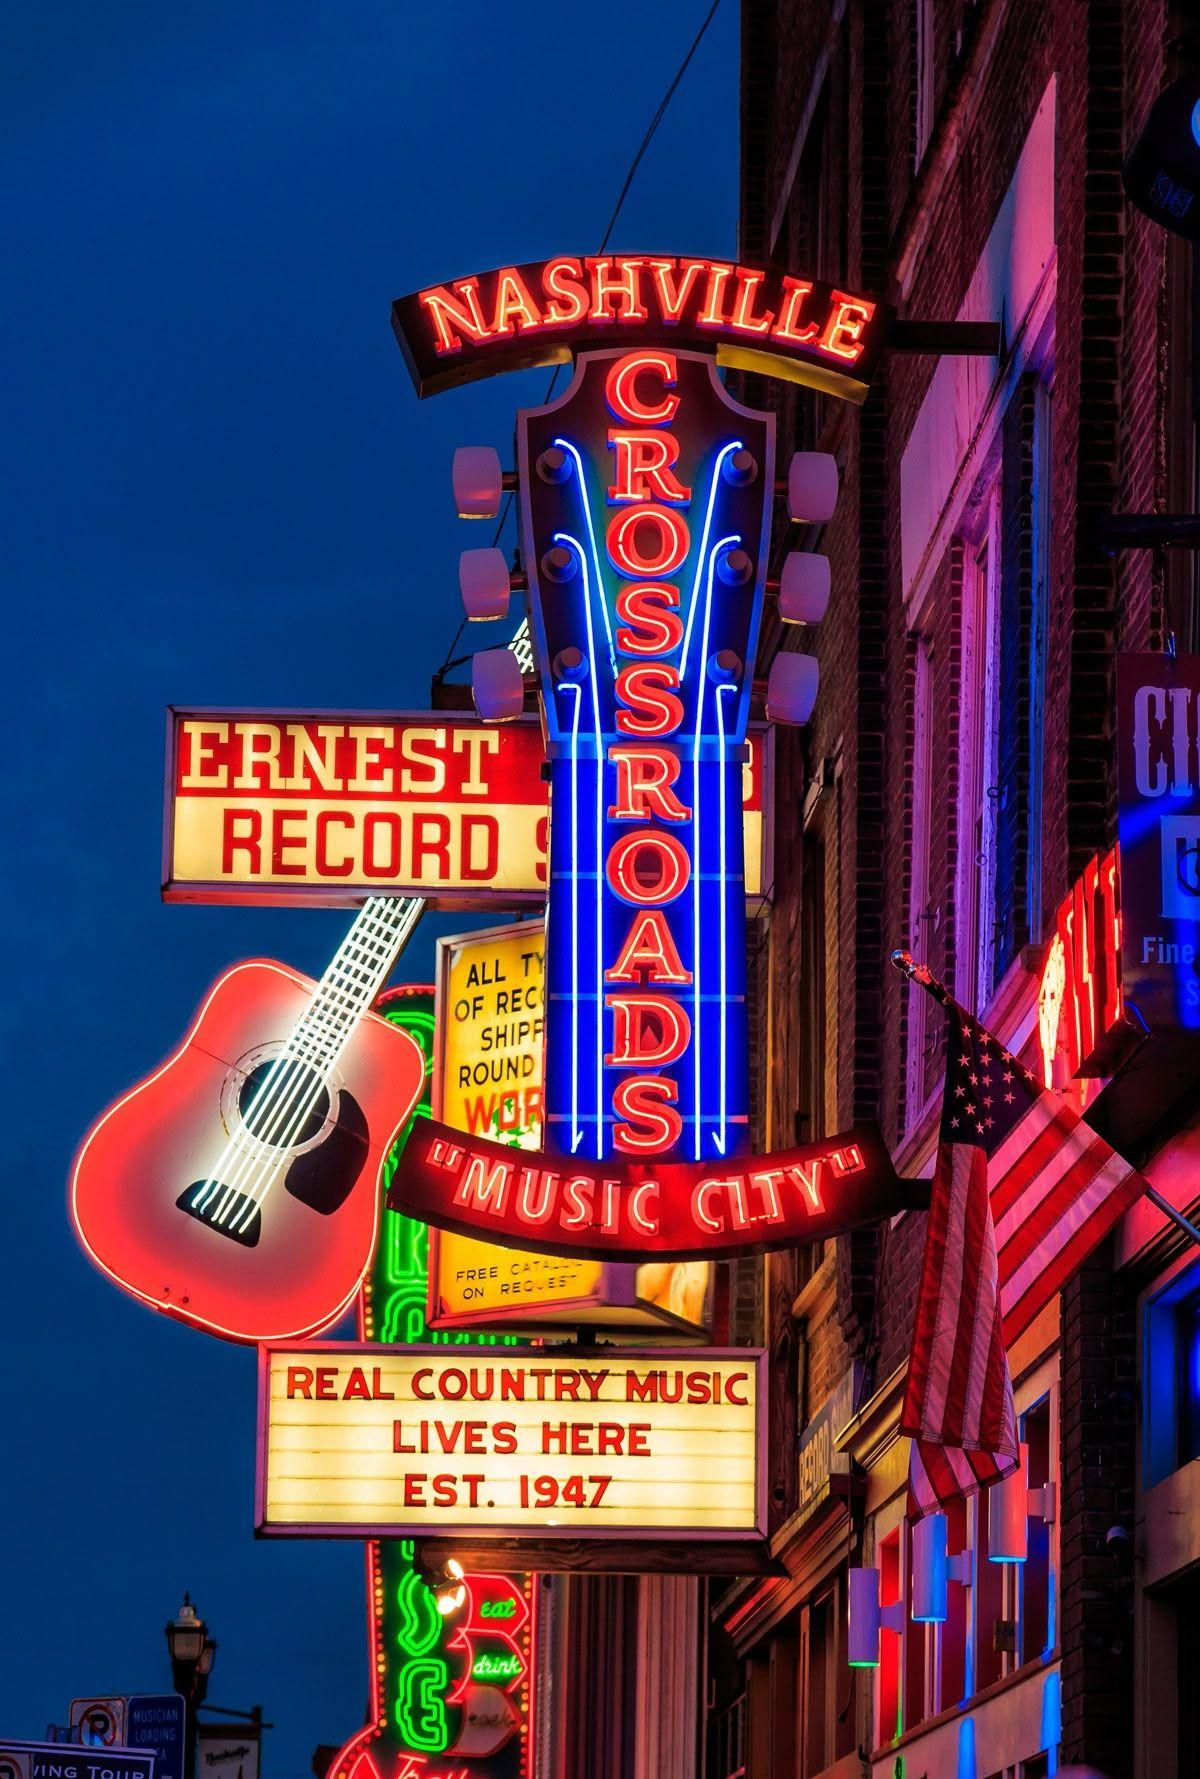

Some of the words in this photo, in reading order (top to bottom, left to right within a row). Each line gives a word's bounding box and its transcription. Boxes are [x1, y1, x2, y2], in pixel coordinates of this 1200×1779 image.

[419, 256, 877, 366] NASHVILLE
[181, 721, 500, 795] ERNEST
[603, 350, 693, 1156] CROSSROADS
[221, 808, 499, 881] RECORD
[1141, 936, 1196, 965] Fine
[466, 959, 506, 989] ALL
[454, 996, 484, 1023] OF
[496, 984, 544, 1016] REC
[459, 1054, 535, 1089] ROUND
[456, 1266, 498, 1283] FREE
[462, 1287, 485, 1300] ON
[500, 1273, 577, 1295] REQUEST
[286, 1366, 395, 1401] REAL
[411, 1368, 611, 1402] COUNTRY
[630, 1369, 749, 1406] MUSIC
[392, 1419, 518, 1455] LIVES
[542, 1421, 652, 1457] HERE
[403, 1473, 495, 1508] EST.
[519, 1474, 613, 1509] 1947
[480, 1597, 517, 1618] eat
[473, 1656, 521, 1675] drink
[133, 1708, 179, 1723] MUSICIAN
[135, 1728, 176, 1742] LOADING
